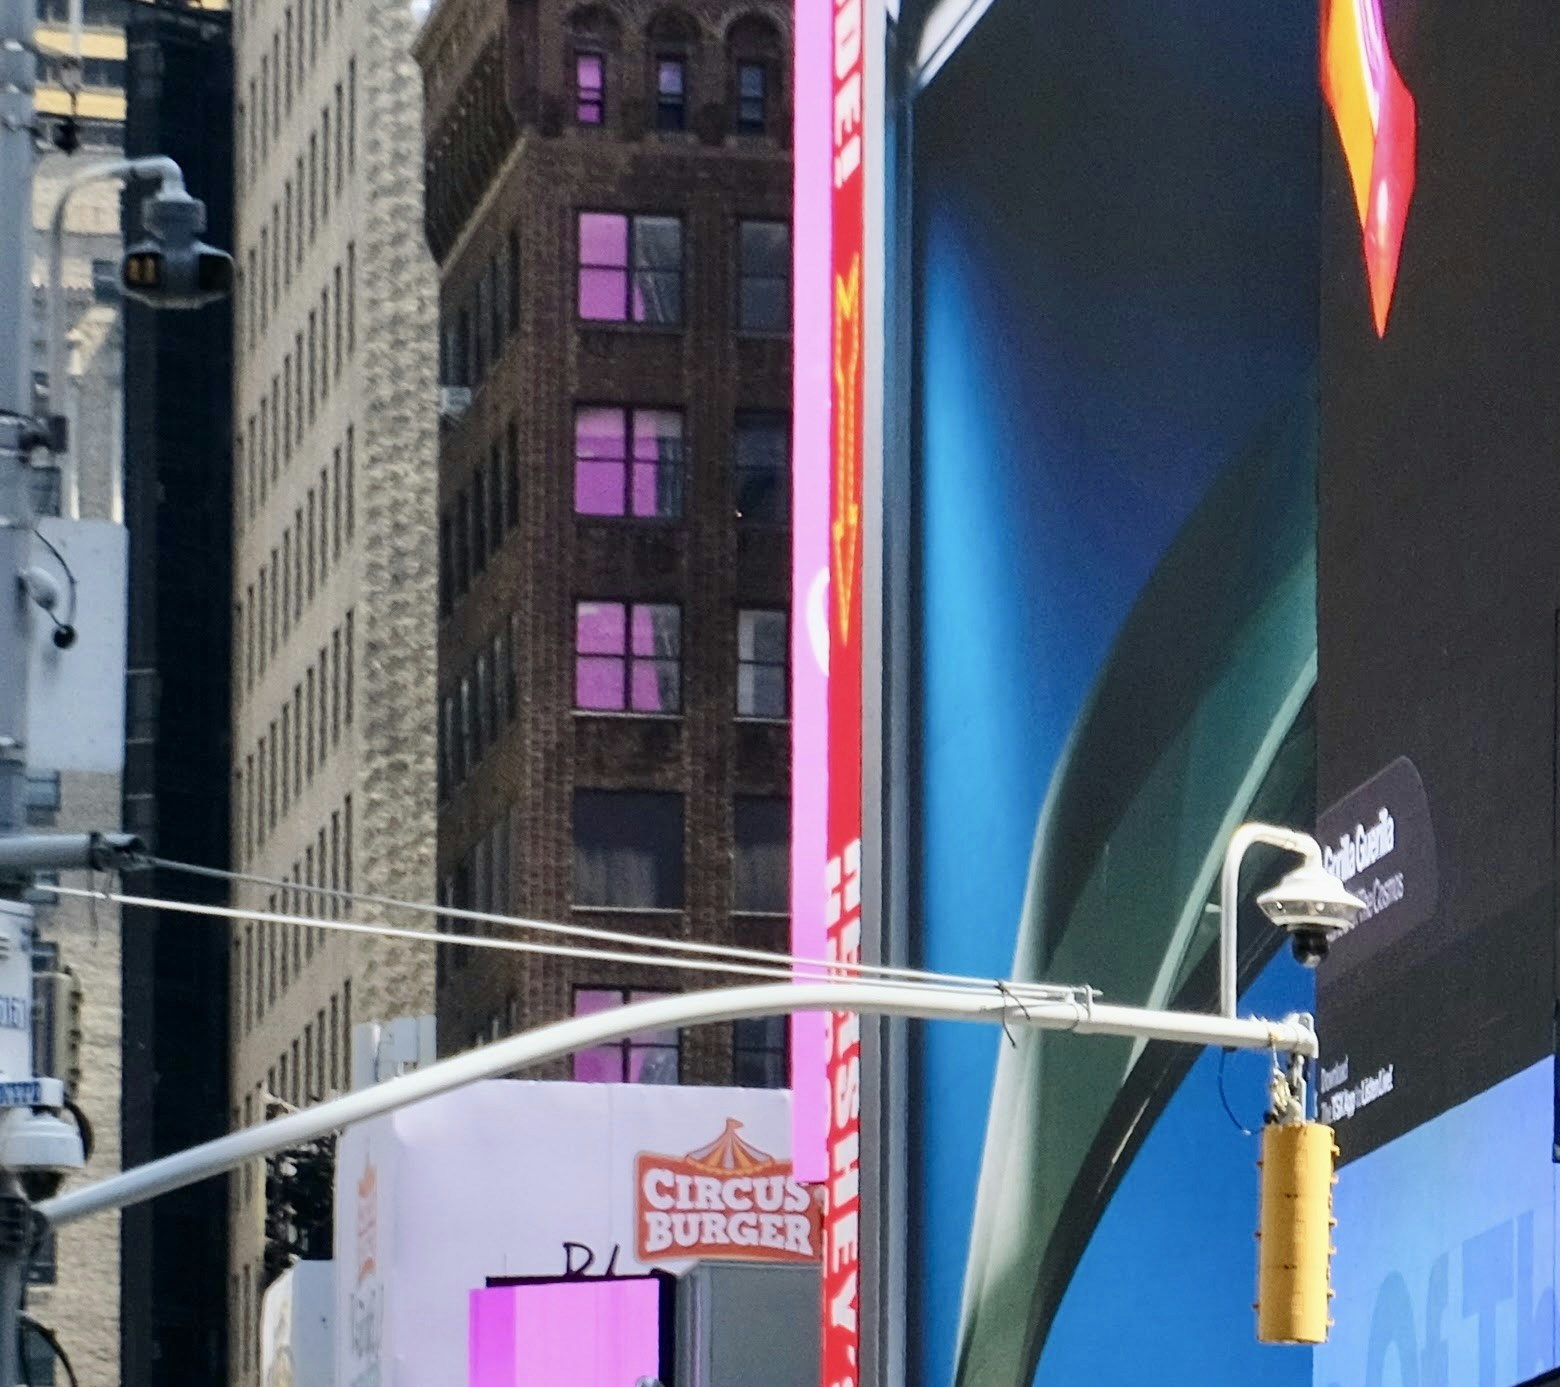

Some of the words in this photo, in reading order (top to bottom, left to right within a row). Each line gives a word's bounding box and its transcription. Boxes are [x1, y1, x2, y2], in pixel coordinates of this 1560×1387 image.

[834, 0, 861, 190] DE!
[641, 1168, 812, 1213] CIRCUS
[645, 1211, 814, 1257] BURGER
